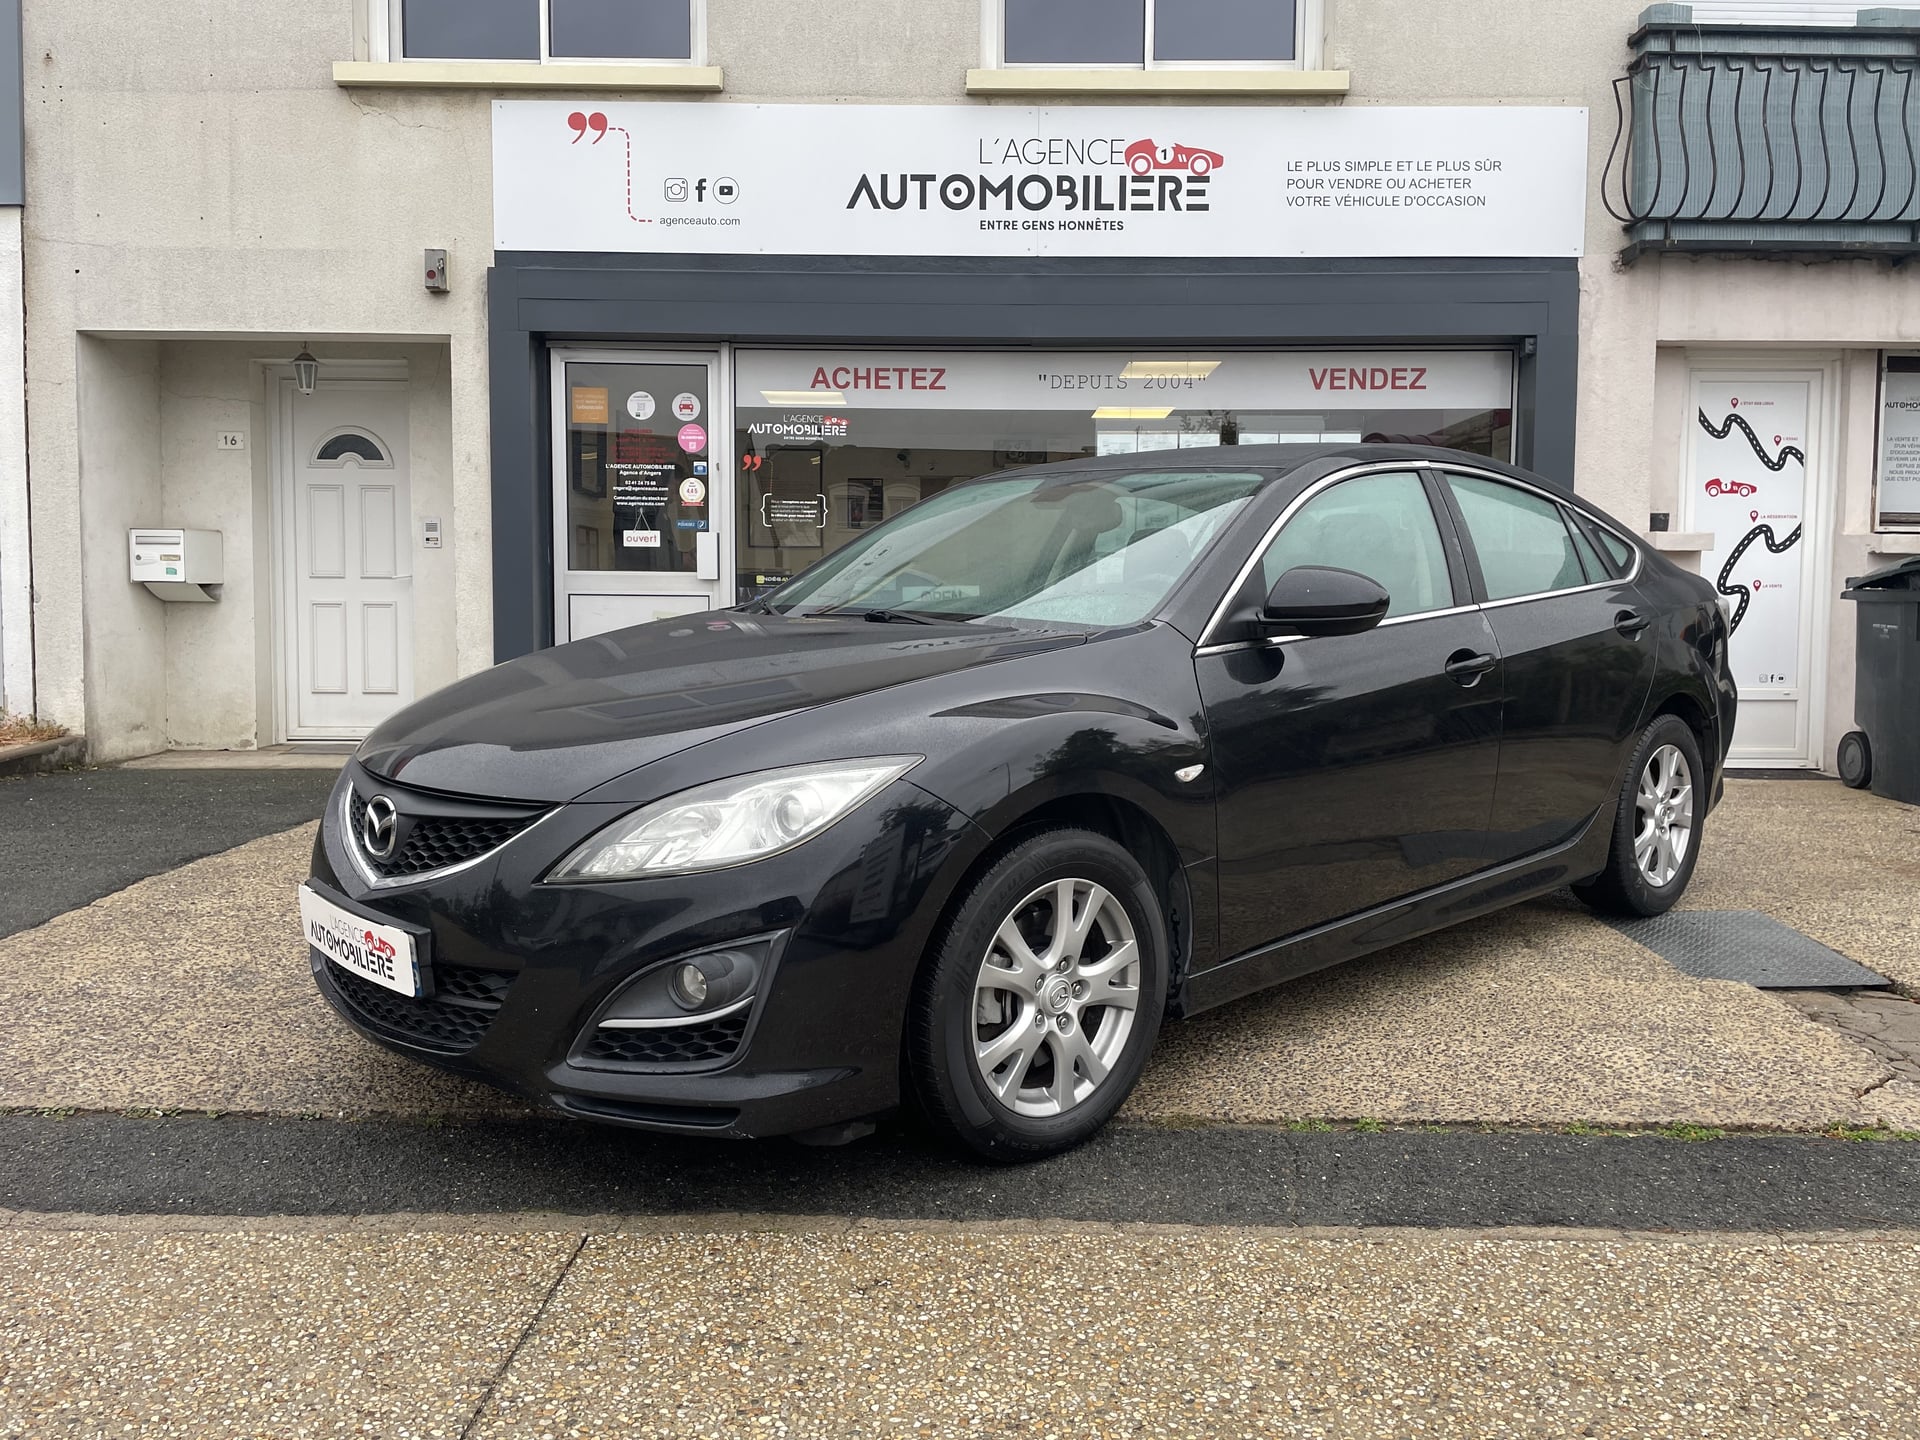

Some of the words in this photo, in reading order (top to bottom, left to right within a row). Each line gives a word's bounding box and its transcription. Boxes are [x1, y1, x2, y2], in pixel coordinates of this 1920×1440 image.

[979, 138, 1125, 165] L'AGENCE
[1161, 149, 1167, 160] 1
[1287, 160, 1303, 171] LE
[1306, 160, 1341, 172] PLUS
[1344, 160, 1393, 172] SIMPLE
[1396, 160, 1413, 171] ET
[1416, 160, 1433, 172] LE
[1436, 160, 1471, 172] PLUS
[1474, 158, 1502, 172] SÛR
[1286, 178, 1325, 190] POUR
[1327, 178, 1383, 189] VENDRE
[1386, 178, 1406, 189] OU
[1408, 178, 1472, 189] ACHETER
[1286, 195, 1331, 207] VOTRE
[1334, 193, 1401, 207] VÉHICULE
[1404, 195, 1486, 207] D'OCCASION
[659, 216, 741, 228] agenceauto.com
[979, 220, 1019, 231] ENTRE
[1021, 220, 1055, 231] GENS
[1058, 218, 1124, 231] HONNÊTES
[811, 369, 945, 390] ACHETEZ
[1311, 369, 1425, 390] VENDEZ
[224, 435, 237, 446] 16
[626, 534, 657, 543] ouvert
